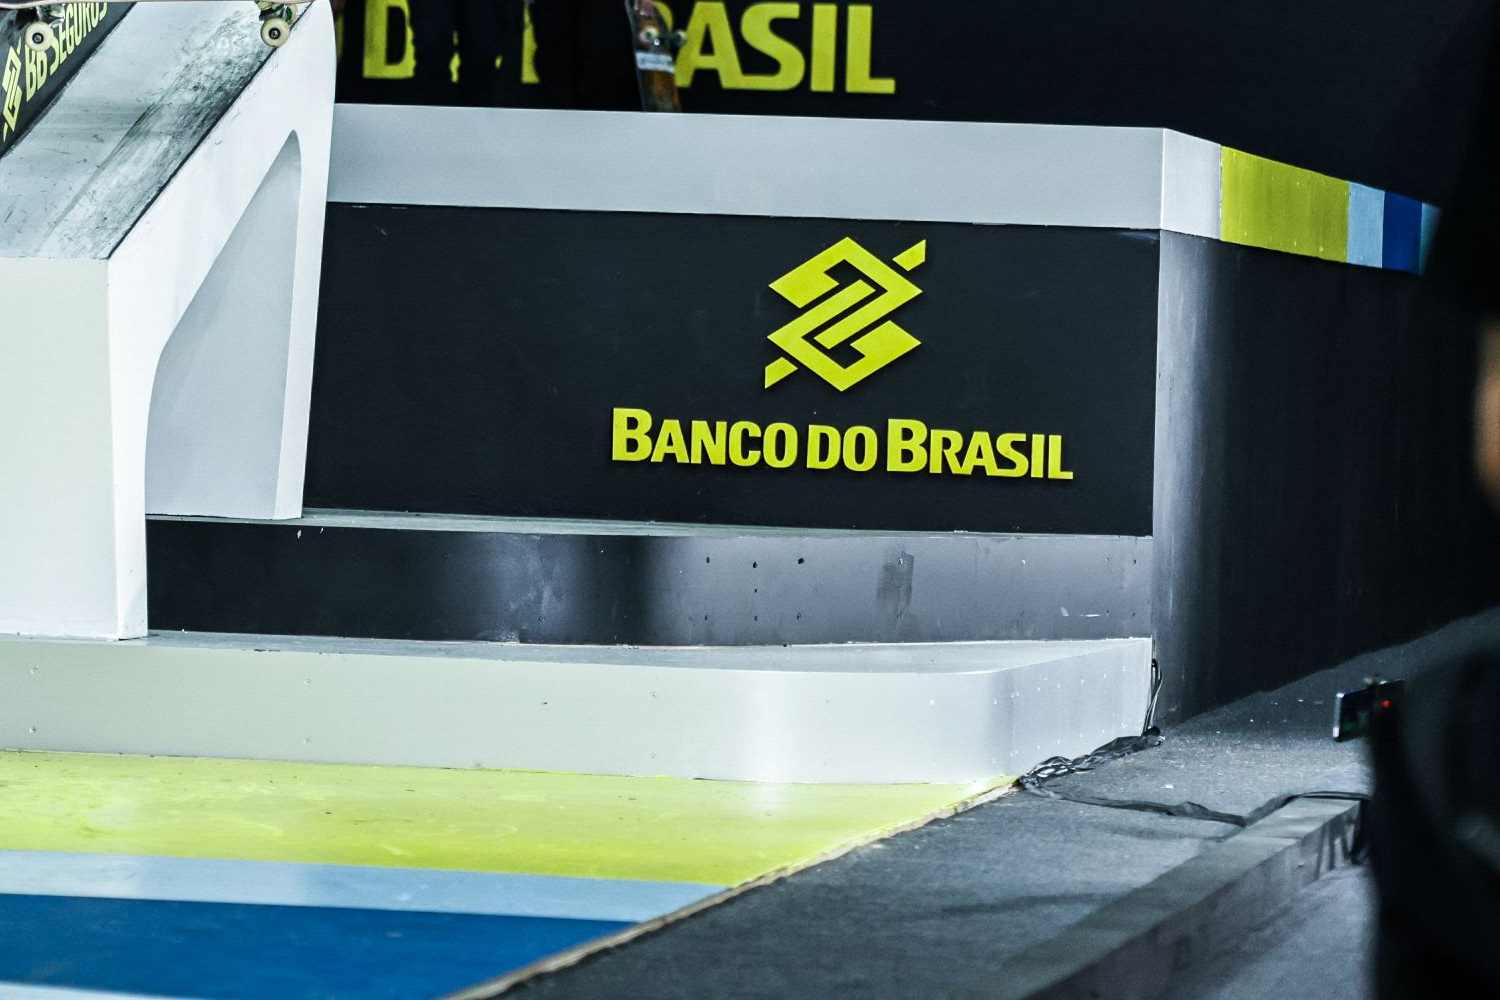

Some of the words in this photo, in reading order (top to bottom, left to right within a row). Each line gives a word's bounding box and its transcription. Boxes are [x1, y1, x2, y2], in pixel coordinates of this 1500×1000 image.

[612, 407, 799, 469] BANCO
[806, 424, 879, 472] DO
[886, 418, 1074, 481] BRASIL
